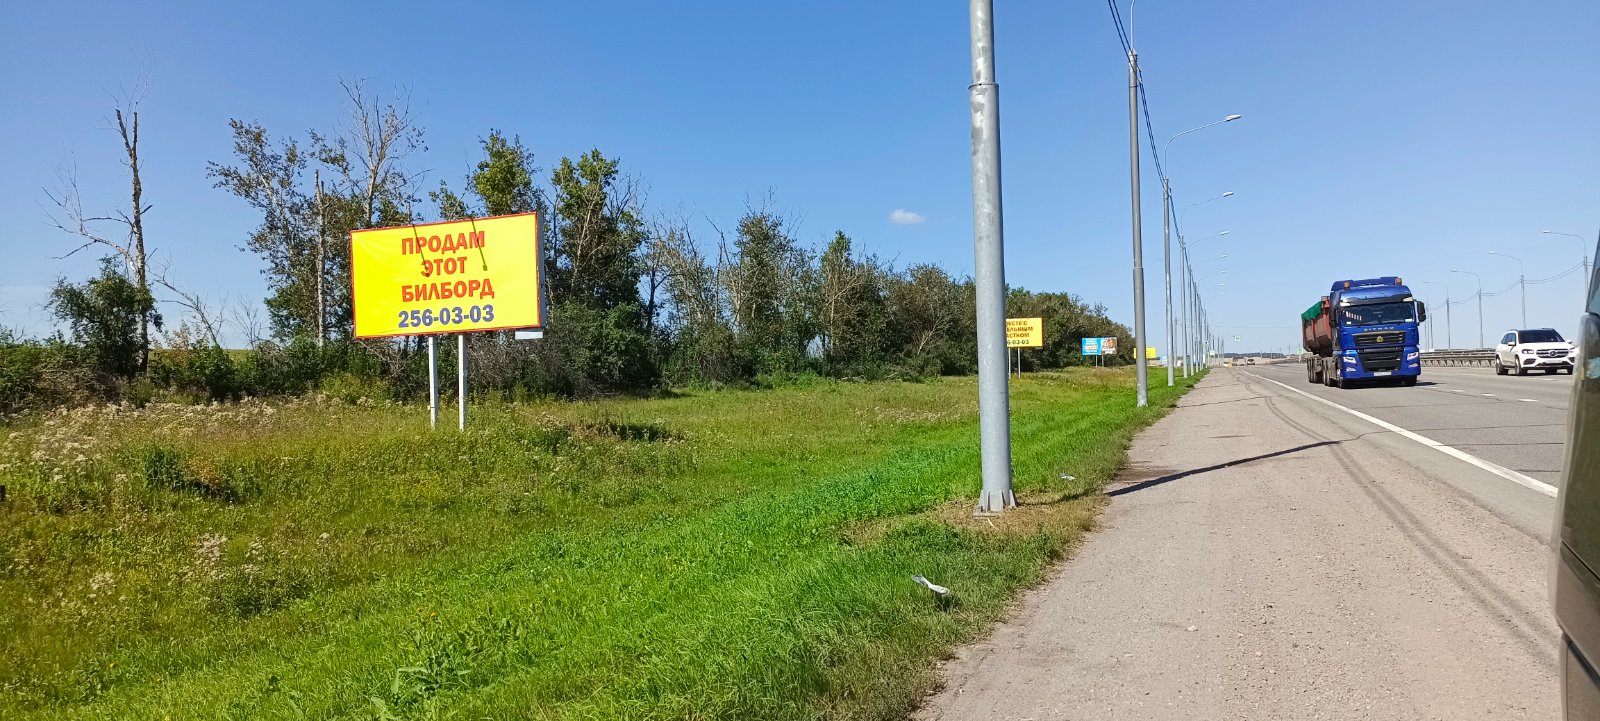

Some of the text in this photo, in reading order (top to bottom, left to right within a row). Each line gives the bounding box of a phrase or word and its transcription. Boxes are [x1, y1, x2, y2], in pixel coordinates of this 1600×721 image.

[401, 231, 485, 255] ПРОДАМ
[420, 257, 467, 277] ЭТОТ
[401, 278, 495, 302] БИЛБОРД
[398, 304, 495, 328] 256-03-03
